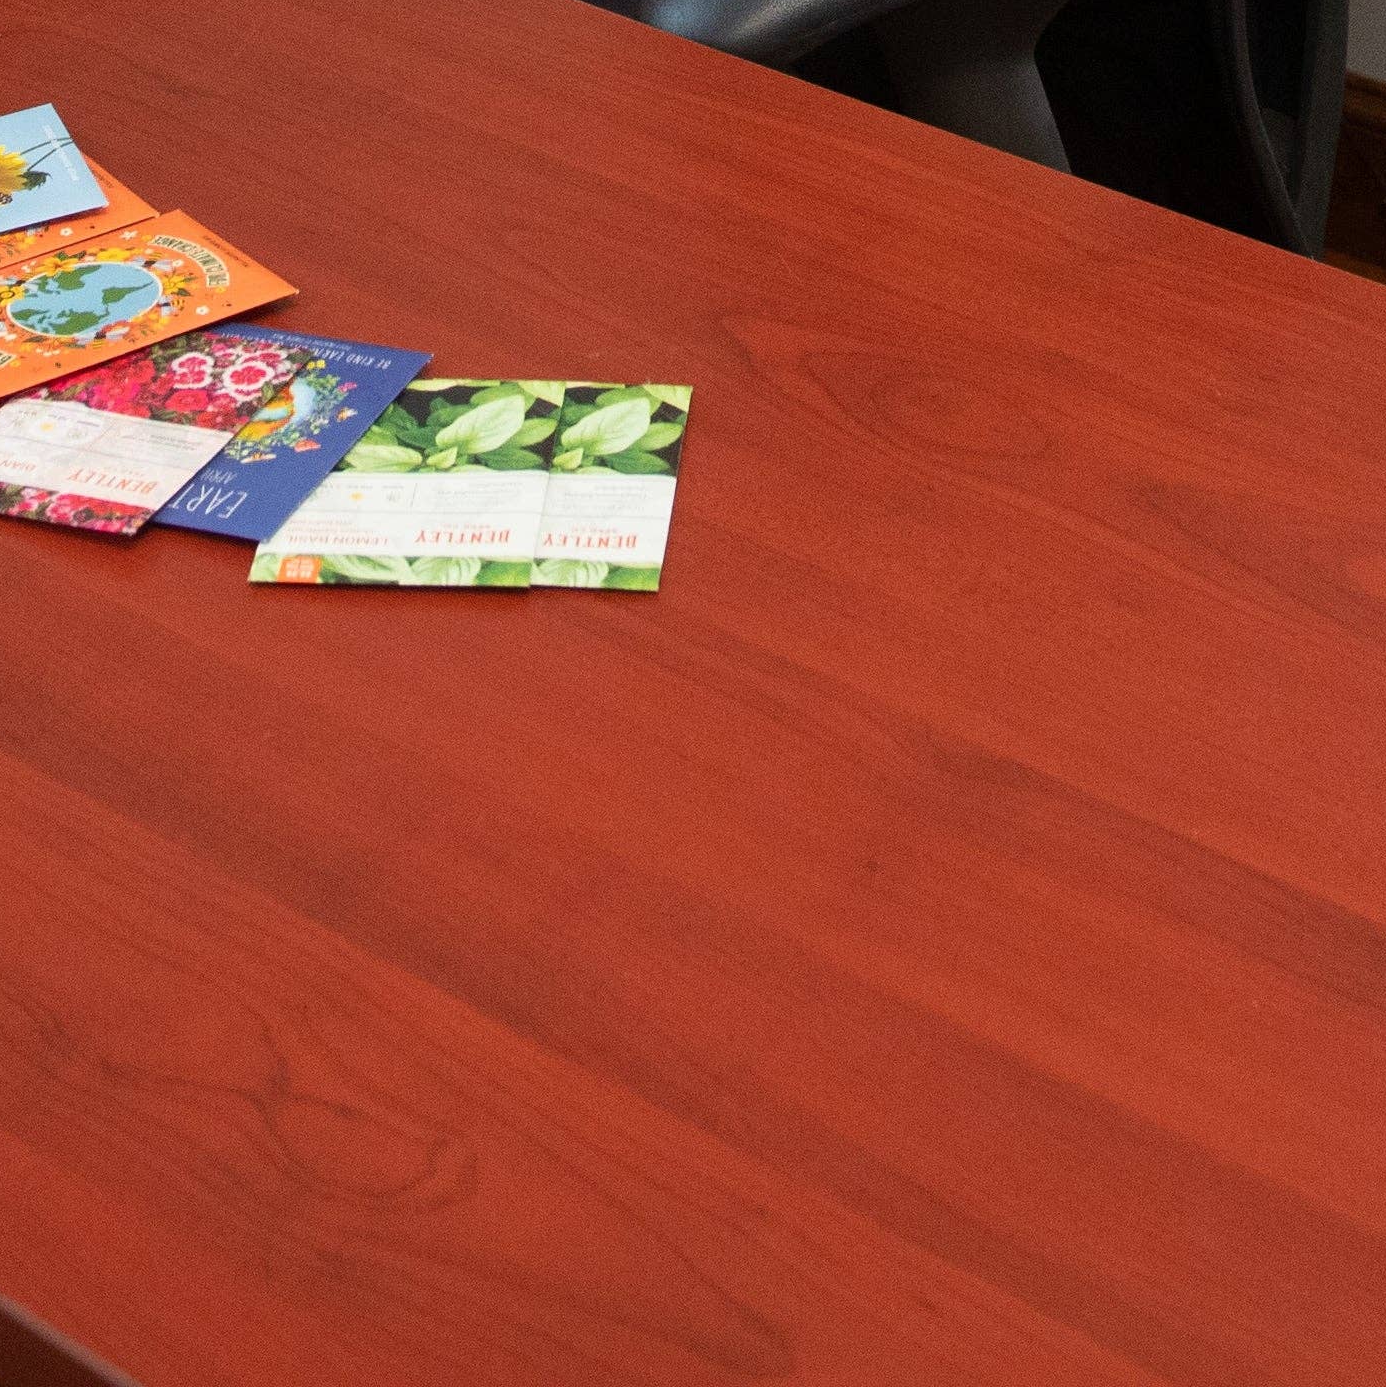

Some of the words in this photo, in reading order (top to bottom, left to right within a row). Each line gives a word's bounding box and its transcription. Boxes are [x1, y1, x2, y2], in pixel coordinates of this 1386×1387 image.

[346, 355, 374, 366] KIND
[376, 359, 392, 369] BE
[68, 467, 160, 494] BENTLEY
[286, 532, 333, 545] BASIL
[333, 533, 390, 546] LEMON
[414, 529, 511, 544] BENTLEY
[542, 533, 638, 548] BENTLEY
